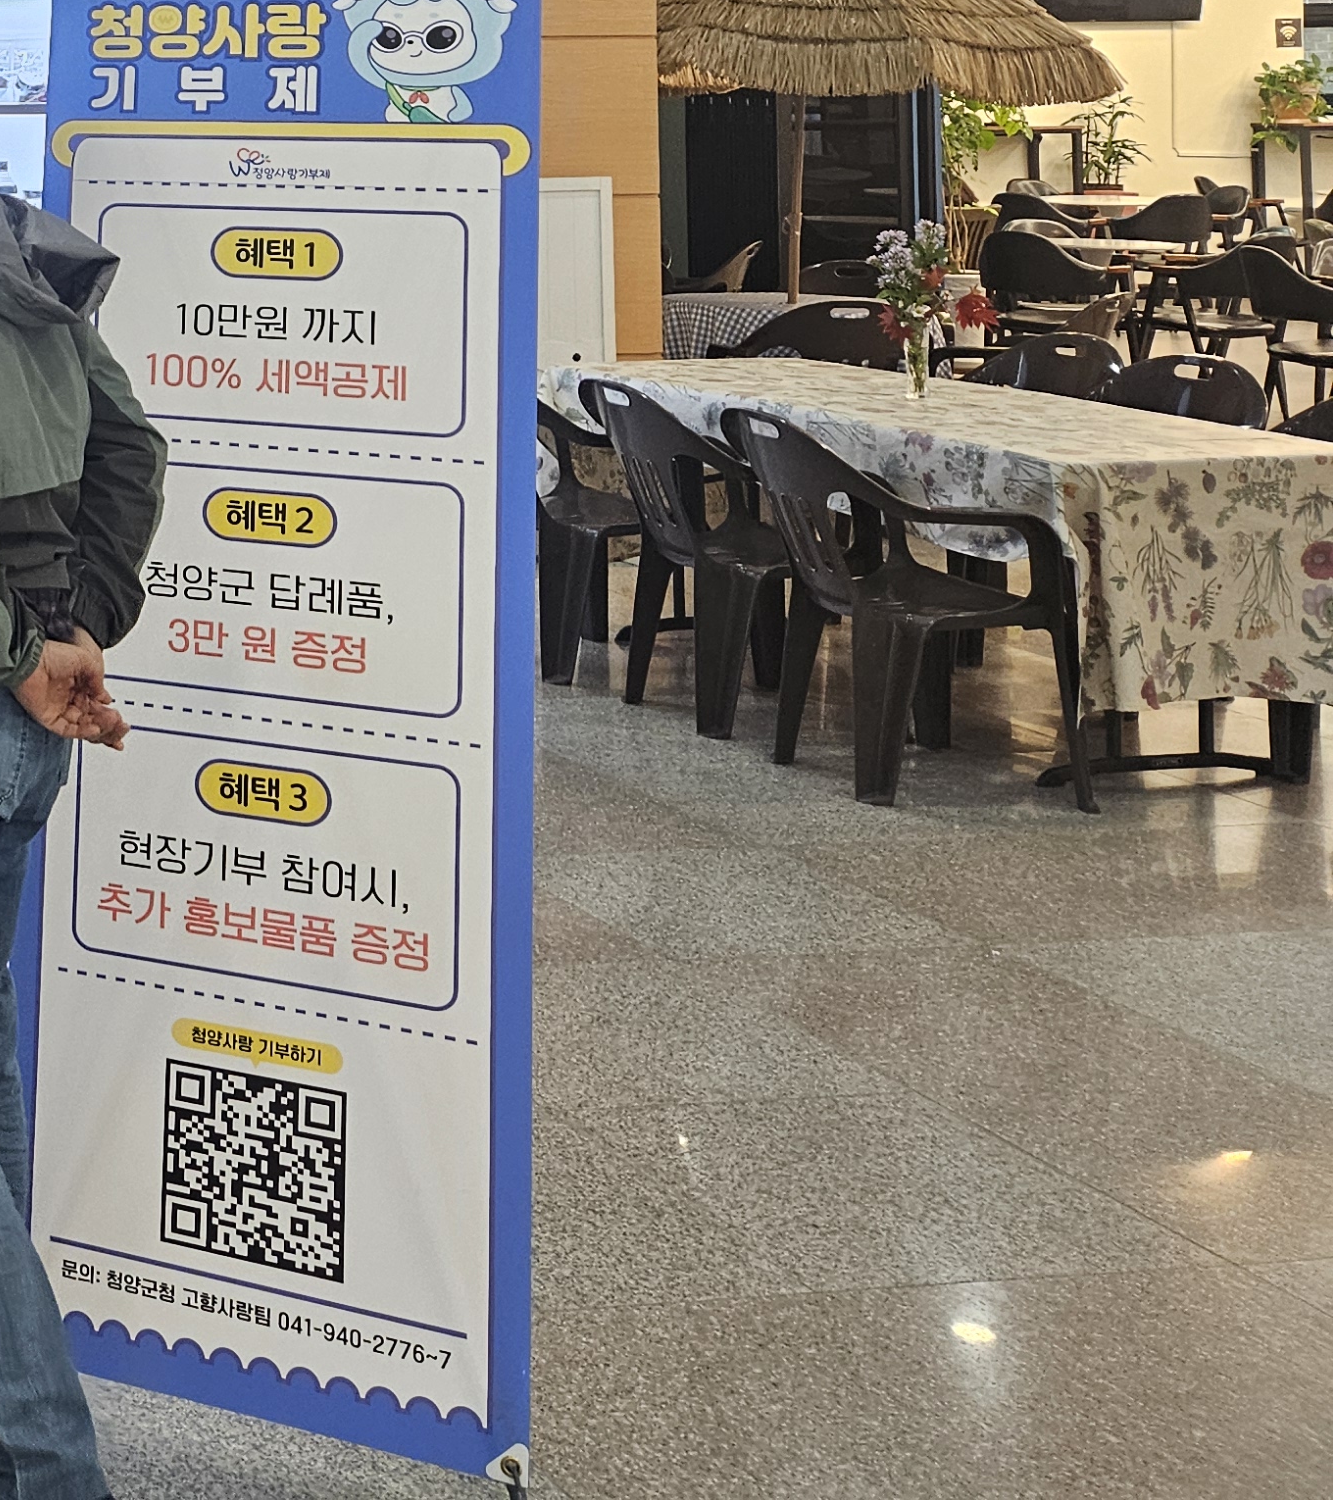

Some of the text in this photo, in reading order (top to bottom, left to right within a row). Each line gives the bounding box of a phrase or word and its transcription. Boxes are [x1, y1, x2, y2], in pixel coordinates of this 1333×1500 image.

[89, 3, 327, 61] 청양사랑
[89, 65, 319, 113] 기부제
[235, 237, 315, 269] 혜택 1
[176, 302, 377, 346] 10만원 까지
[145, 352, 408, 402] 100% 세액공제
[226, 499, 314, 534] 혜택 2
[145, 559, 394, 625] 청양군 답례품,
[168, 618, 367, 674] 3만 원 증정
[219, 770, 308, 812] 혜택 3
[119, 828, 410, 914] 현장기부 참여시,
[97, 882, 430, 972] 추가 홍보물품 증정
[191, 1025, 323, 1067] 청양사랑 기부하기
[61, 1259, 453, 1370] 문의: 청양군청 고향사랑팀 041-940-2776~7
